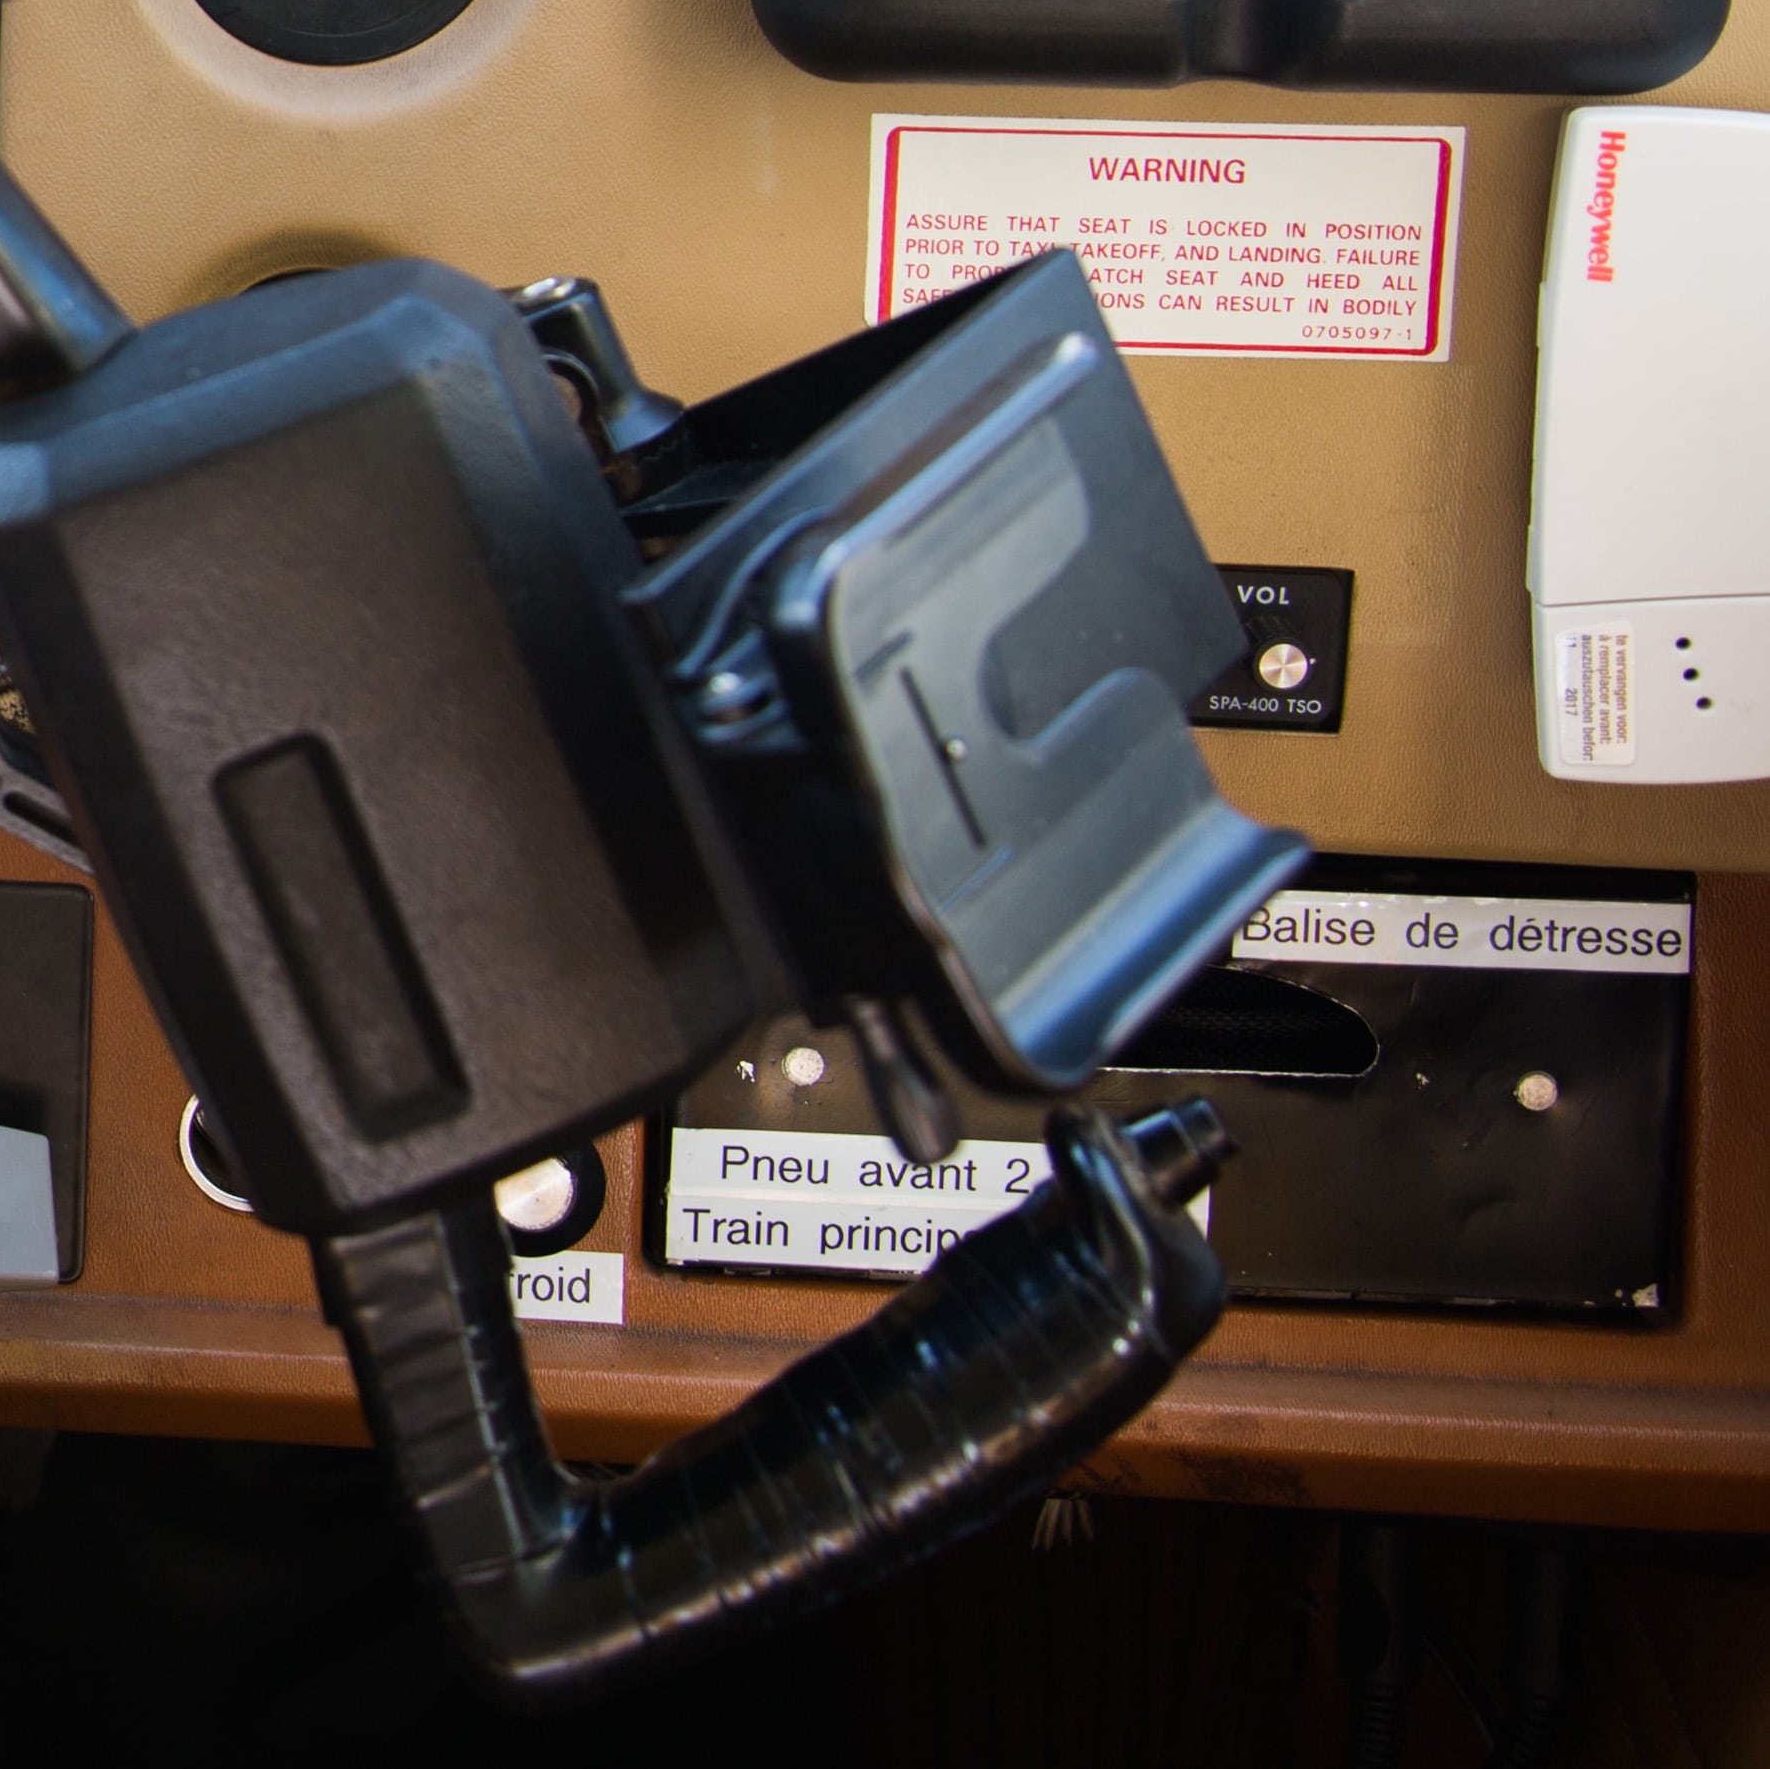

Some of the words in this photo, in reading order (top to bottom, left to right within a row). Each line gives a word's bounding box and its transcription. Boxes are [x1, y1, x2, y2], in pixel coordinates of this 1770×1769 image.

[1089, 157, 1246, 184] WARNING
[1587, 131, 1626, 282] Honeywell
[906, 215, 987, 231] ASSURE
[1007, 216, 1060, 233] THAT
[1078, 217, 1131, 234] SEAT
[1150, 219, 1167, 235] IS
[1187, 220, 1267, 238] LOCKED
[1286, 222, 1306, 238] IN
[1326, 224, 1421, 241] POSITION
[906, 239, 964, 255] PRIOR
[974, 240, 999, 256] TO
[1175, 246, 1219, 262] AND
[1336, 249, 1420, 265] FAILURE
[906, 264, 931, 279] TO
[1166, 270, 1218, 286] SEAT
[1241, 272, 1284, 289] AND
[1307, 273, 1360, 289] HEED
[1383, 275, 1418, 291] ALL
[1159, 295, 1202, 311] CAN
[1216, 296, 1295, 313] RESULT
[1309, 298, 1328, 313] IN
[1343, 299, 1416, 316] BODILY
[1237, 586, 1289, 604] VOL
[1209, 696, 1278, 712] SPA-400
[1287, 700, 1322, 713] TSO
[1565, 688, 1578, 716] 2017
[1241, 907, 1375, 946] Balise
[1406, 914, 1458, 950] de
[1489, 916, 1682, 957] détresse
[721, 1146, 829, 1184] Pneu
[860, 1158, 976, 1191] avant
[683, 1209, 789, 1246] Train
